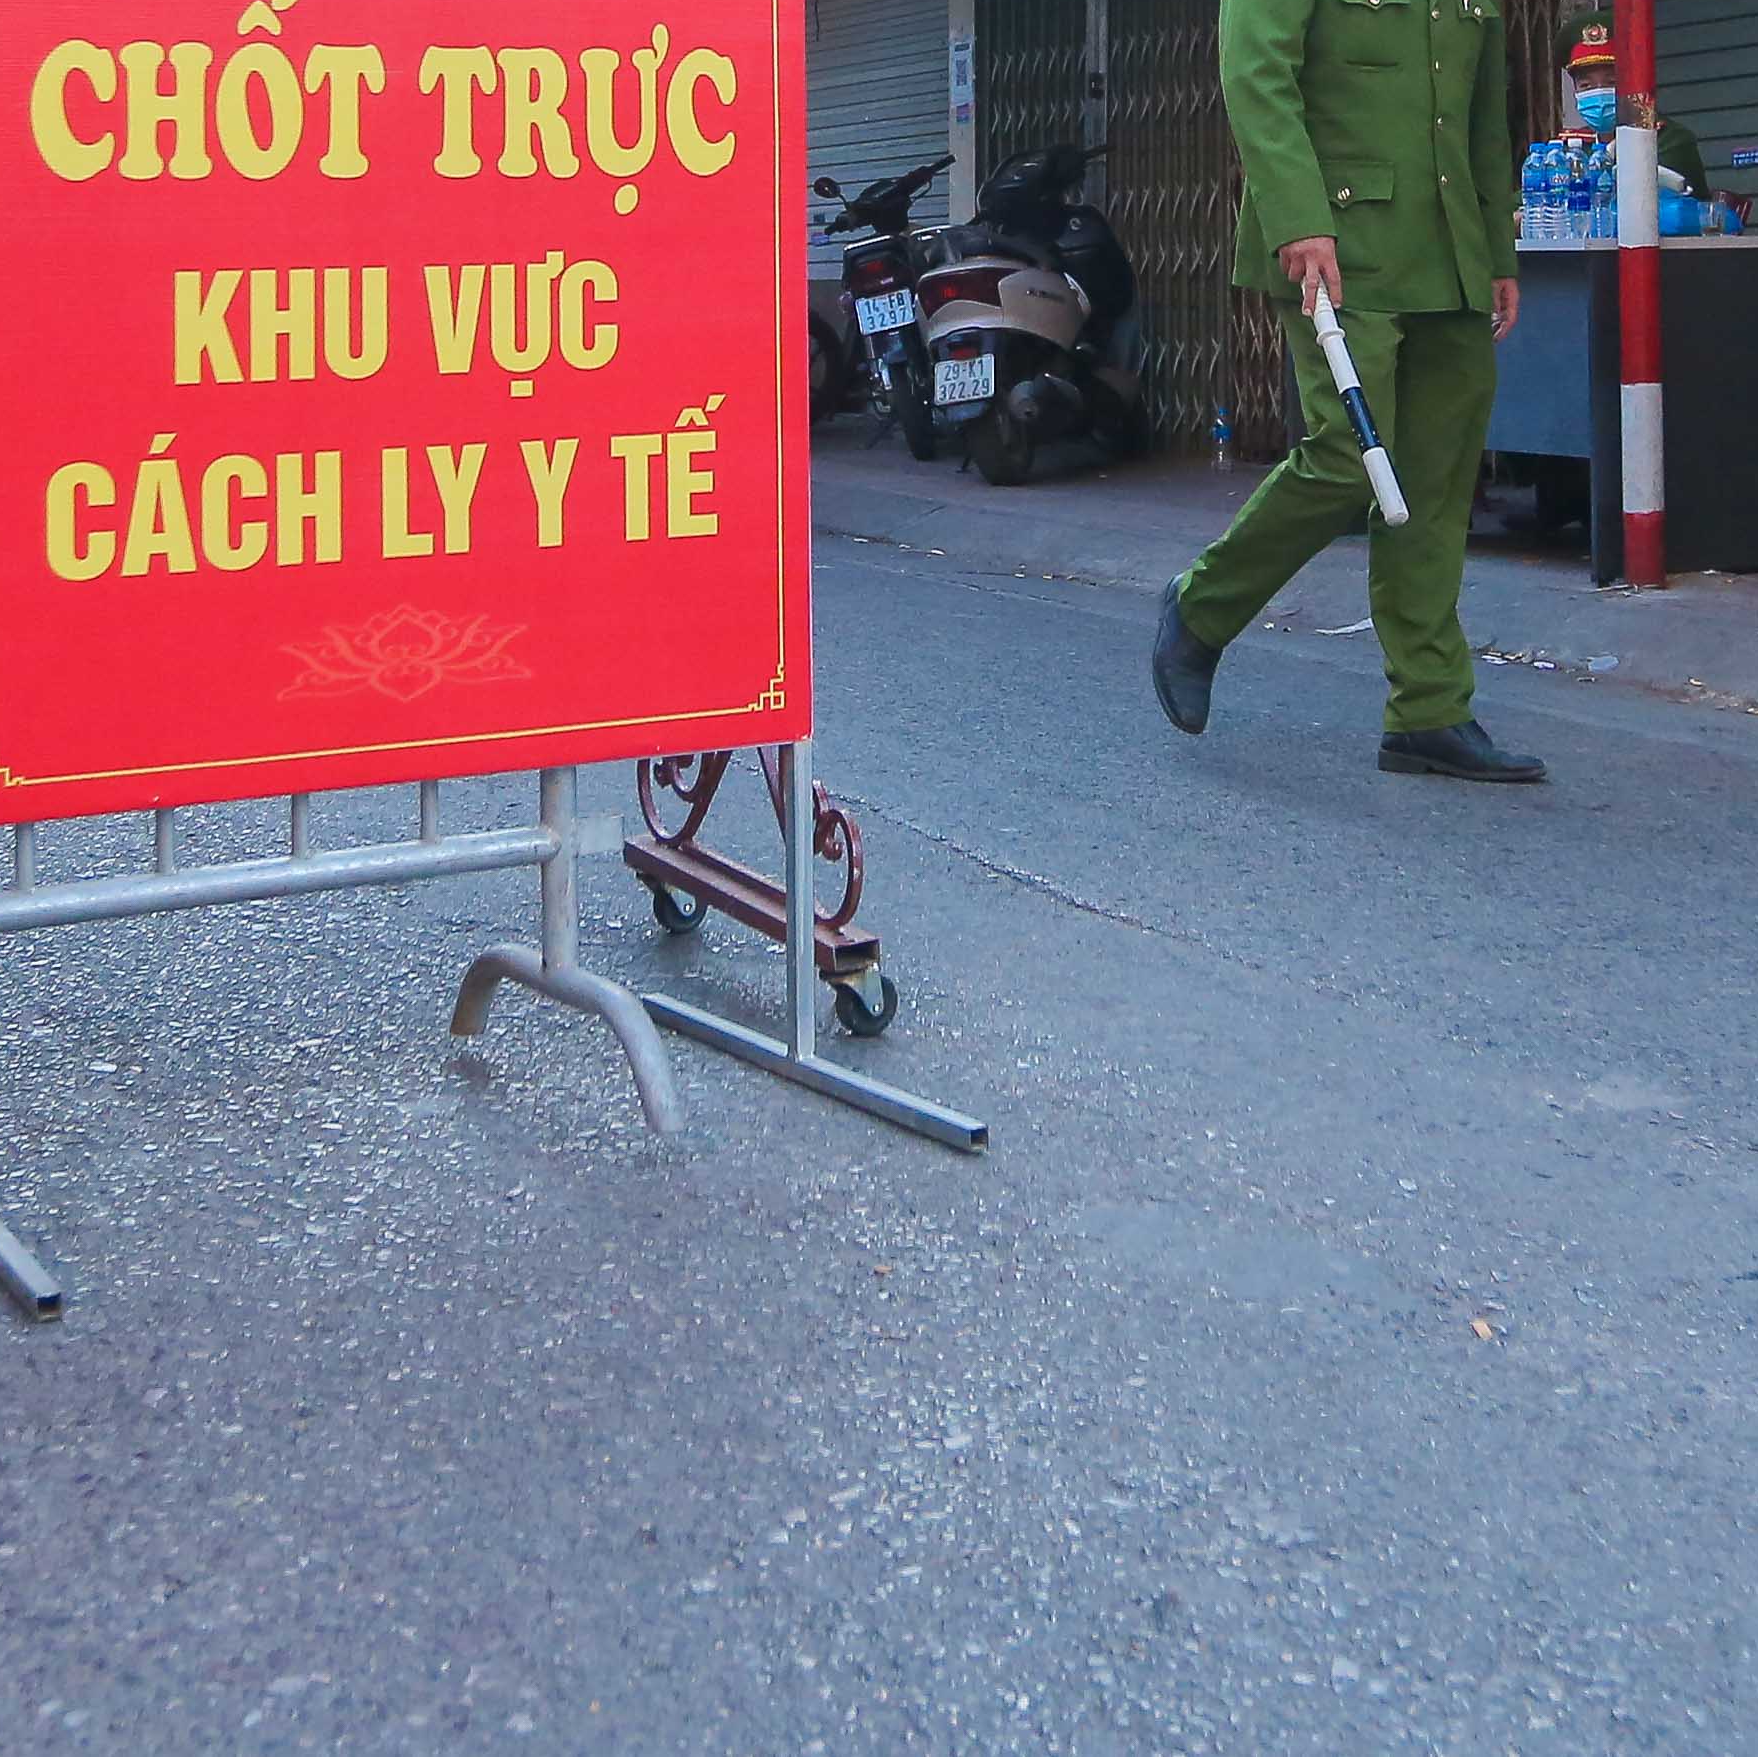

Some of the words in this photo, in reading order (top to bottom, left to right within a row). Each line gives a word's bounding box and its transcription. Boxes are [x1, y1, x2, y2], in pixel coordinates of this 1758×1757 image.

[417, 23, 739, 215] TRỰC
[173, 265, 389, 385] KHU
[424, 250, 619, 398] VỰC
[867, 306, 907, 330] 3297
[939, 378, 989, 400] 322.29
[945, 360, 983, 381] 29-K1
[45, 432, 342, 582] CÁCH
[381, 441, 488, 559] LY
[519, 438, 581, 548] Y
[609, 393, 726, 542] TẾ
